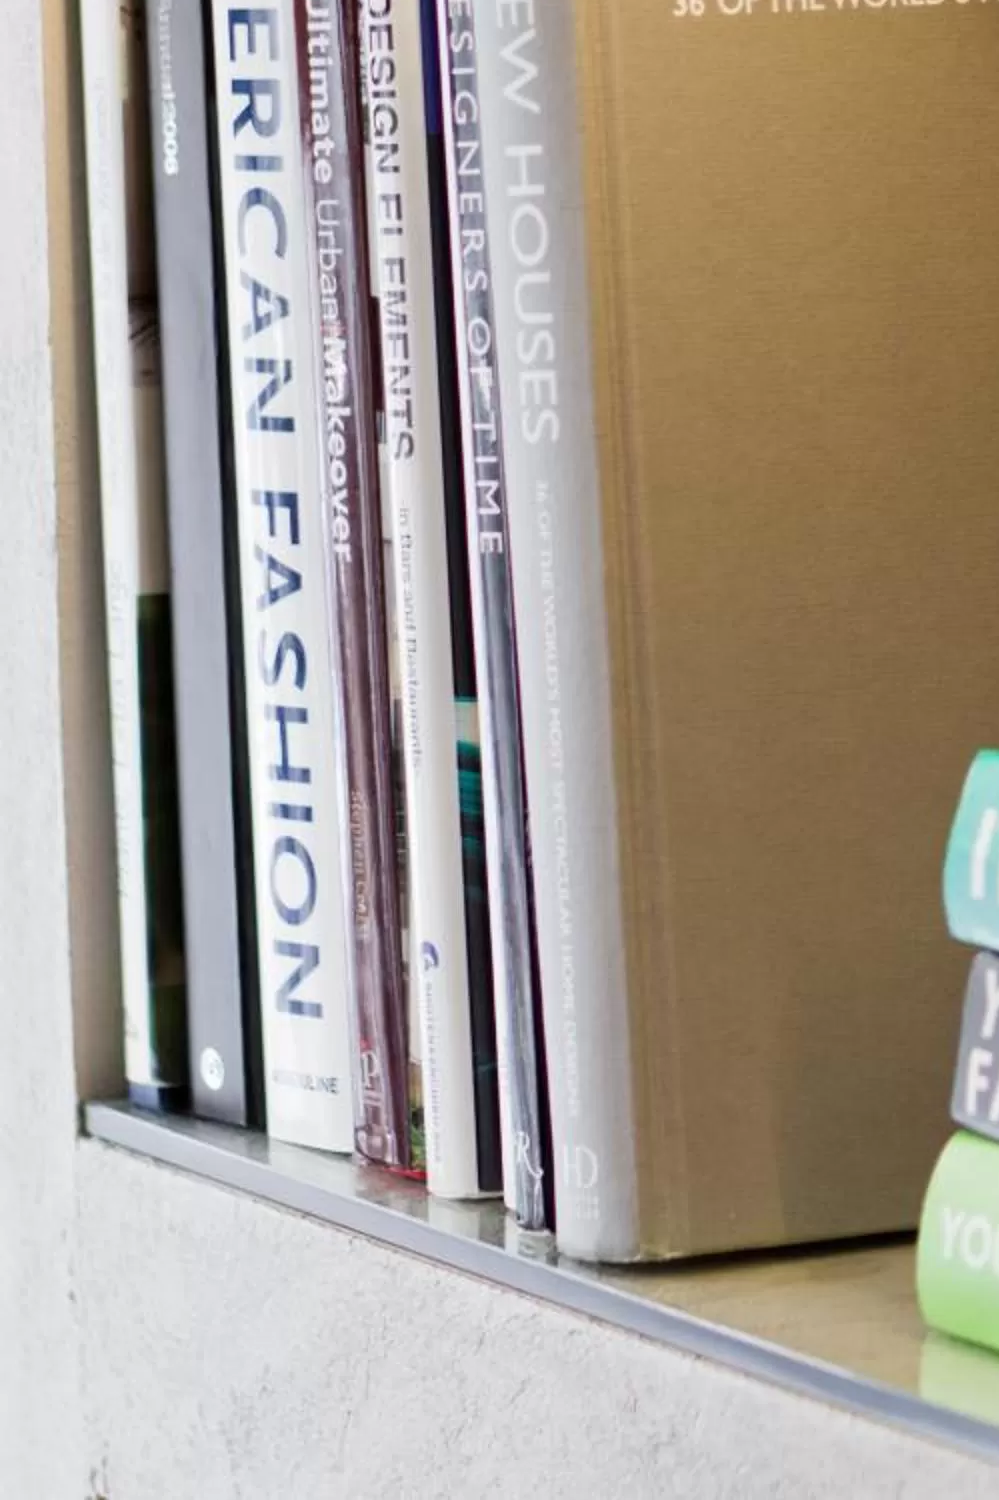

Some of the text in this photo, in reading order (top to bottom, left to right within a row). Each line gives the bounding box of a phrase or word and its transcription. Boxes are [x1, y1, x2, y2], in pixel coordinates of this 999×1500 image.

[313, 197, 343, 325] Urban
[467, 317, 493, 385] OF
[505, 144, 559, 445] HOUSES
[320, 333, 351, 564] Makeover
[473, 413, 504, 554] TIME
[251, 489, 323, 1020] FASHION
